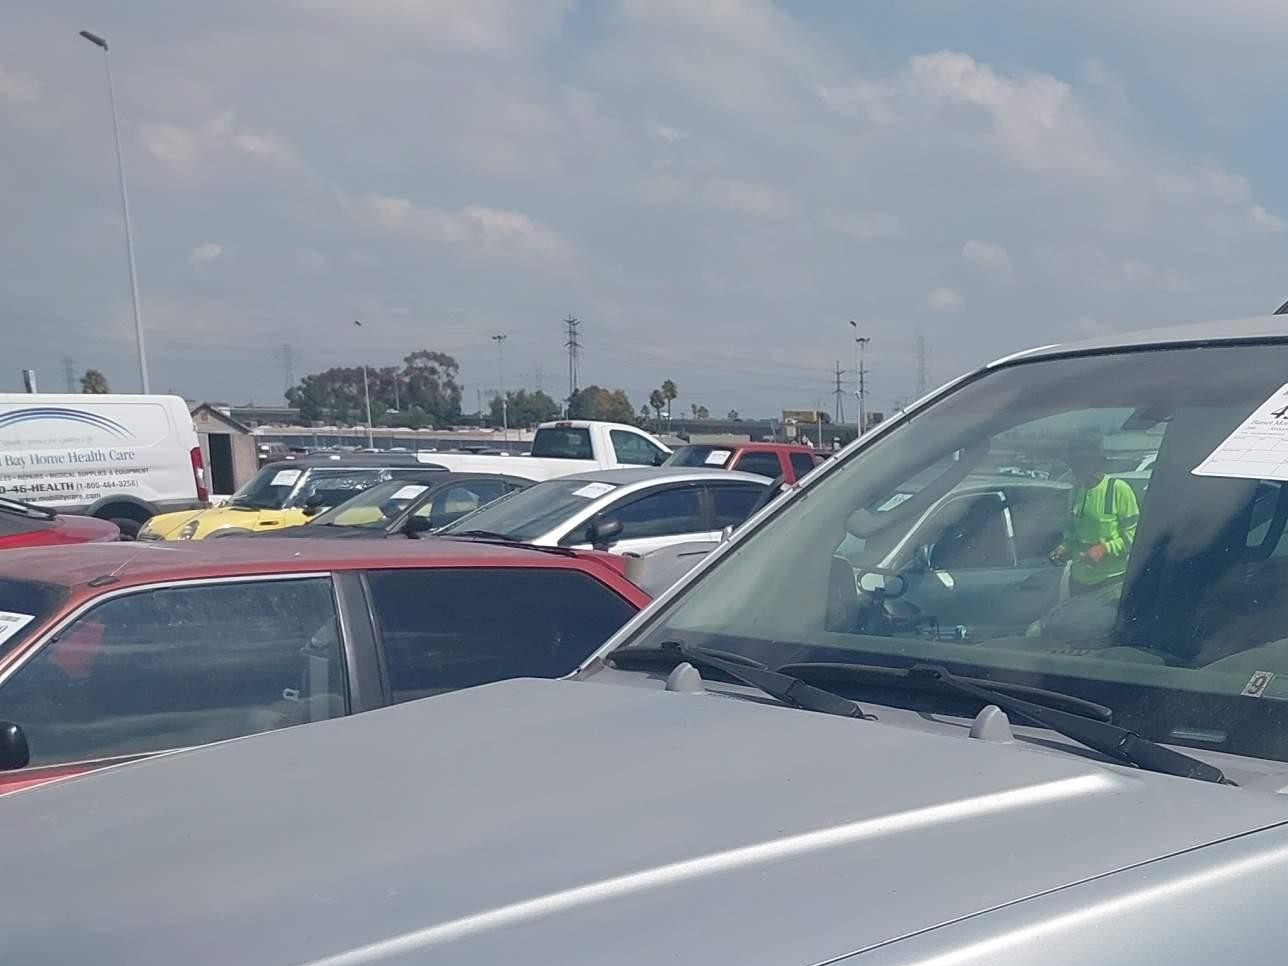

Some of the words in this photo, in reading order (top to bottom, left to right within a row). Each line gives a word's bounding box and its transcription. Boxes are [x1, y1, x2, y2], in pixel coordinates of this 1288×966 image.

[5, 454, 26, 469] Bay
[30, 453, 65, 465] Home
[68, 450, 106, 463] Health
[109, 449, 135, 462] Care
[1248, 675, 1267, 694] 9
